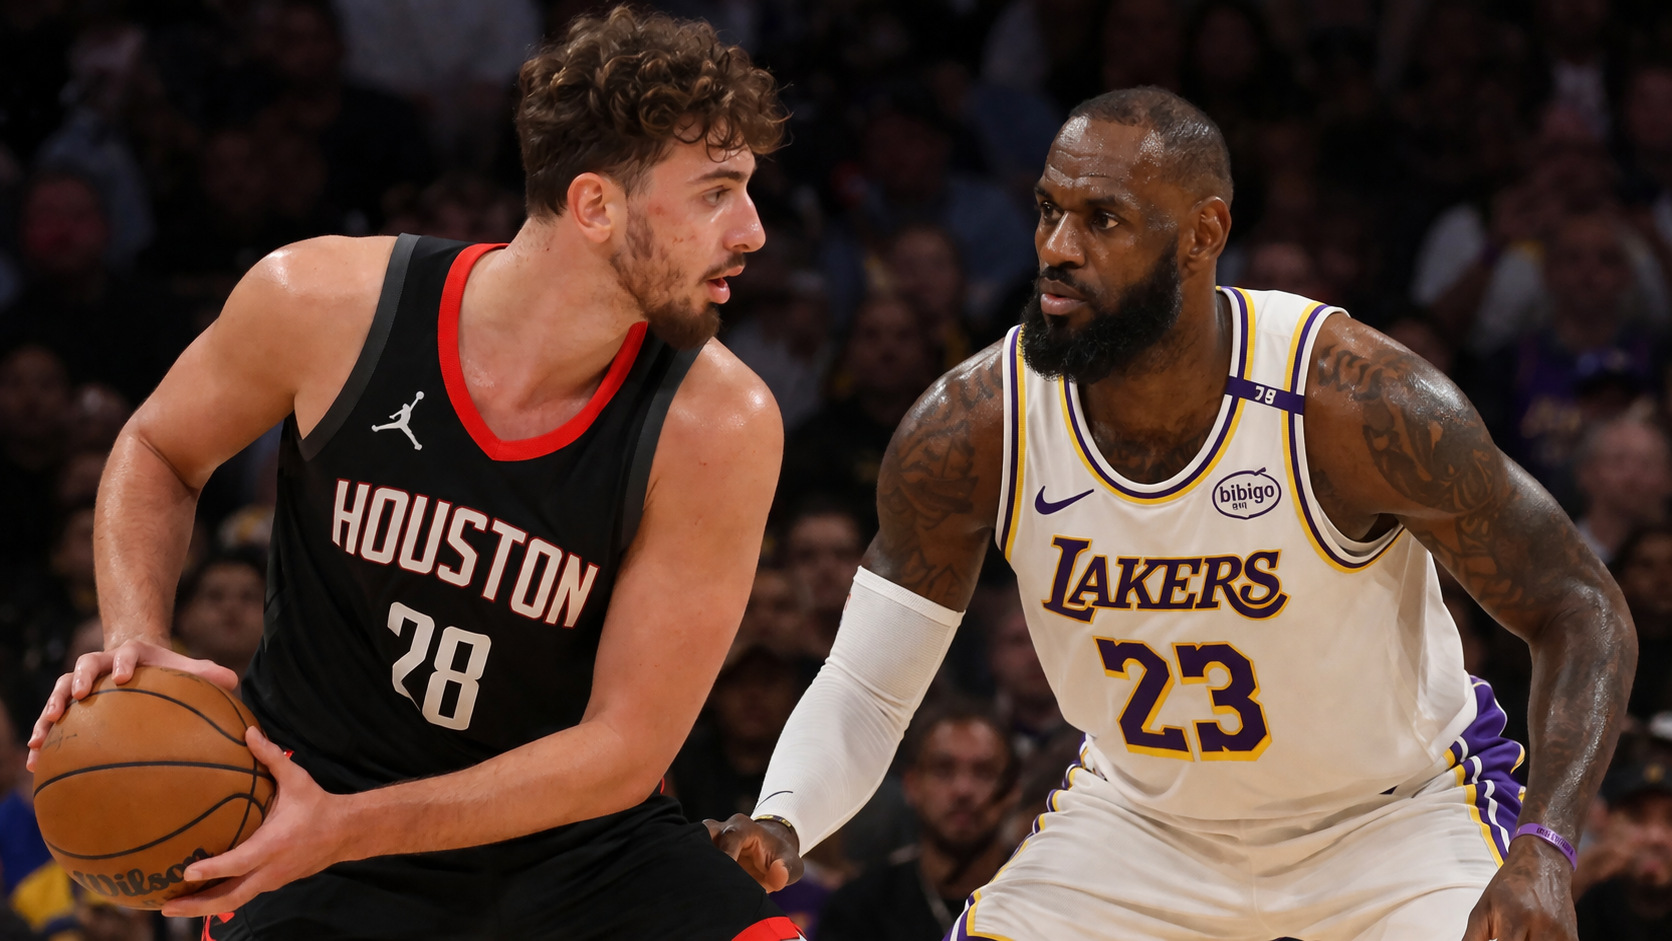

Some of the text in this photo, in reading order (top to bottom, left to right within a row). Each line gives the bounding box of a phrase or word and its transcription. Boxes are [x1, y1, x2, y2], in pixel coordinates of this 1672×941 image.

[332, 478, 600, 628] HOUSTON
[1219, 482, 1275, 504] bibigo
[1041, 534, 1291, 625] LAKERS
[387, 601, 492, 731] 28
[1092, 635, 1273, 762] 23
